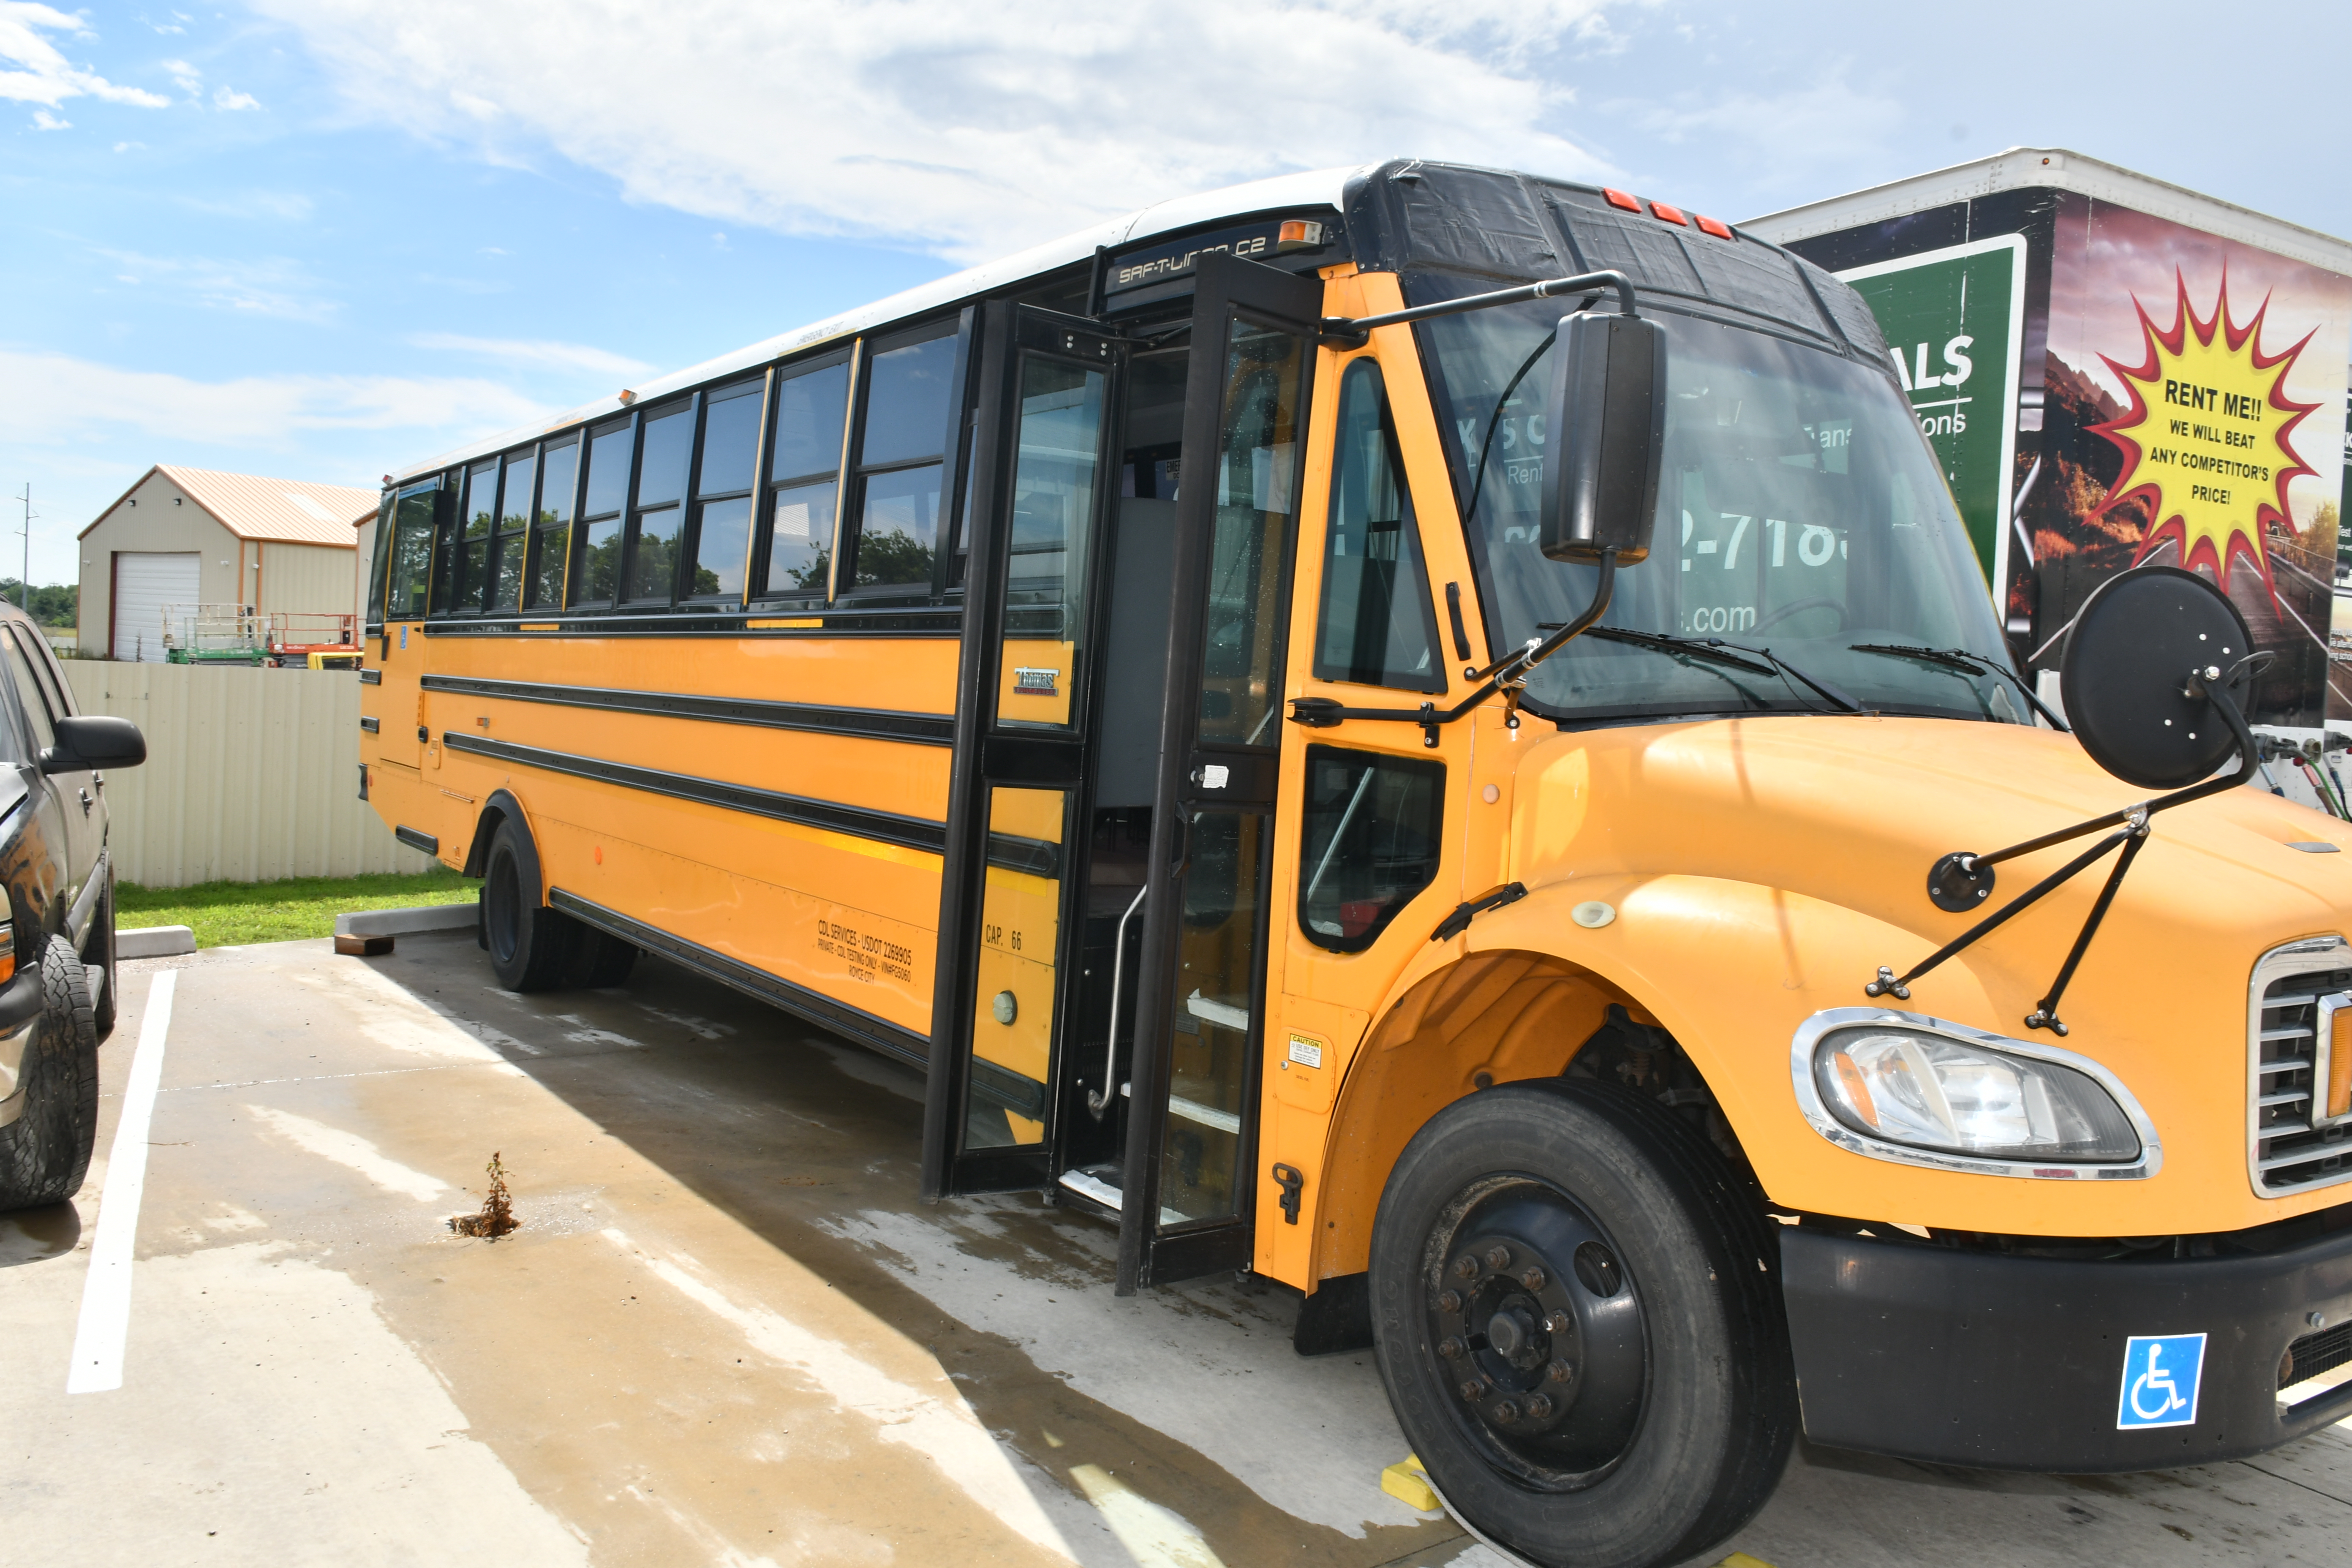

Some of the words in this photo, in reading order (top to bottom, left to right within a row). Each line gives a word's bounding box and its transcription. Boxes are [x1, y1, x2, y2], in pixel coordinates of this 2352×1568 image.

[1236, 237, 1266, 256] C2
[2165, 379, 2218, 412] RENT
[2224, 392, 2262, 422] ME!!
[2170, 419, 2189, 436] WE
[2193, 423, 2221, 443] WILL
[2225, 430, 2255, 449] BEAT
[2150, 446, 2177, 465] ANY
[2181, 452, 2269, 482] COMPETITOR'S
[2191, 485, 2231, 505] PRICE!
[1015, 667, 1059, 689] Thomas
[818, 919, 830, 937] CDL
[831, 923, 857, 947] SERVICES
[861, 933, 882, 956] USDOT
[986, 924, 1003, 946] CAP.
[1012, 930, 1021, 951] 66
[818, 938, 834, 954] PRIVATE
[837, 945, 846, 958] CDL
[847, 948, 864, 965] TESTING
[866, 955, 877, 969] ONLY
[849, 964, 863, 981] ROYCE
[865, 971, 875, 985] CITY
[1293, 1036, 1319, 1048] CAUTION
